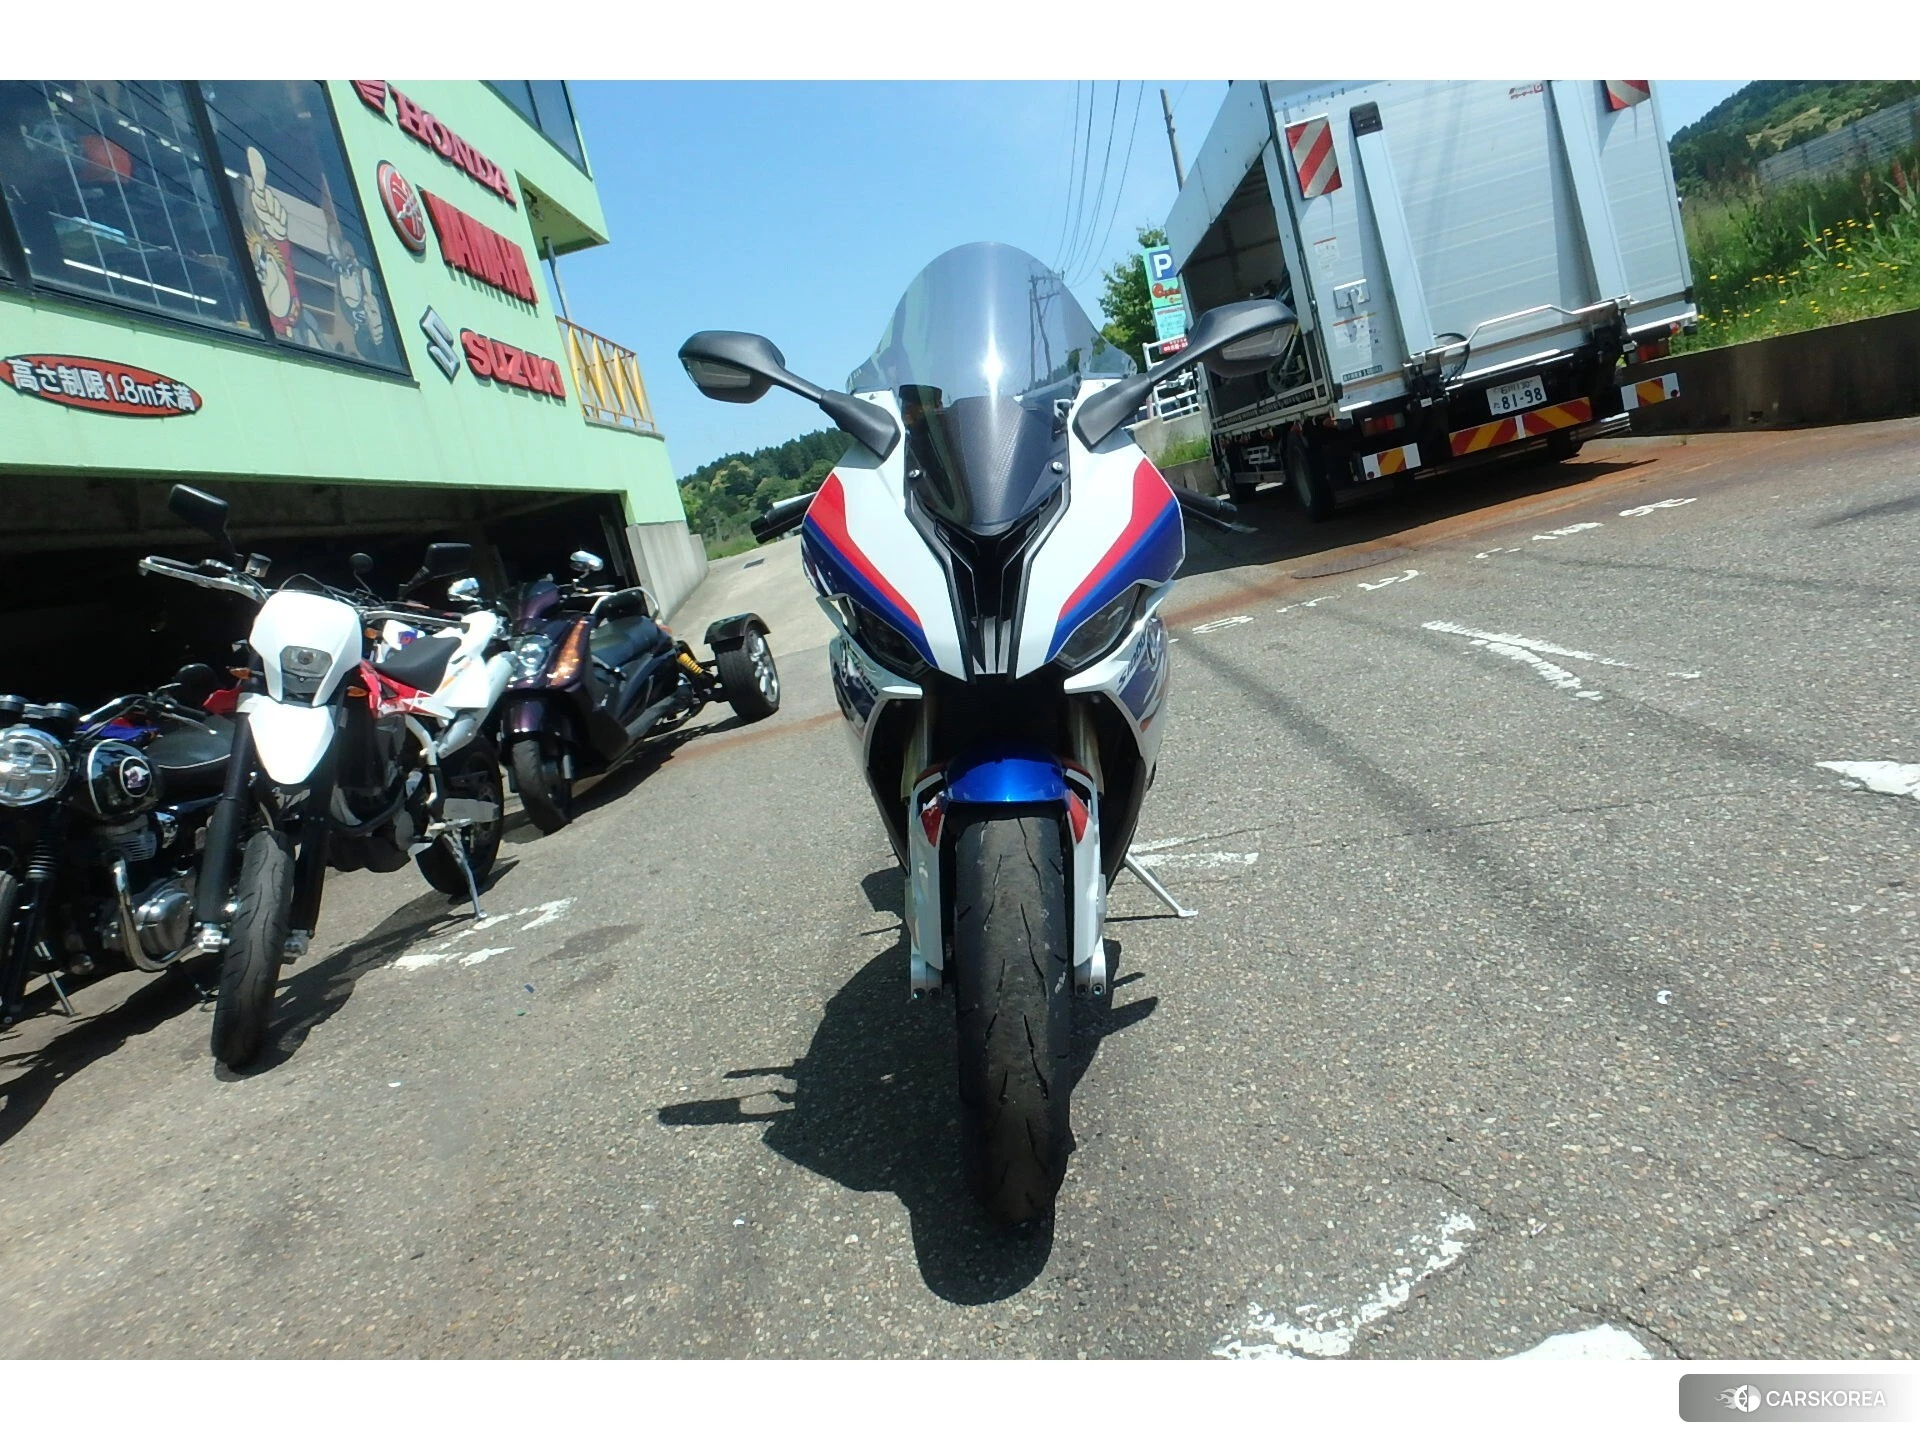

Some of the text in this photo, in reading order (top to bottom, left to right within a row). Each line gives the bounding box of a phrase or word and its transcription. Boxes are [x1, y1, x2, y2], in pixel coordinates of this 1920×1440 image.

[391, 85, 516, 206] HONDA
[417, 185, 538, 304] YAMAHA
[1153, 253, 1172, 277] P
[7, 358, 196, 411] 高さ制限1.8m未満
[460, 328, 566, 398] SUZUKI
[1502, 387, 1542, 409] 81-98
